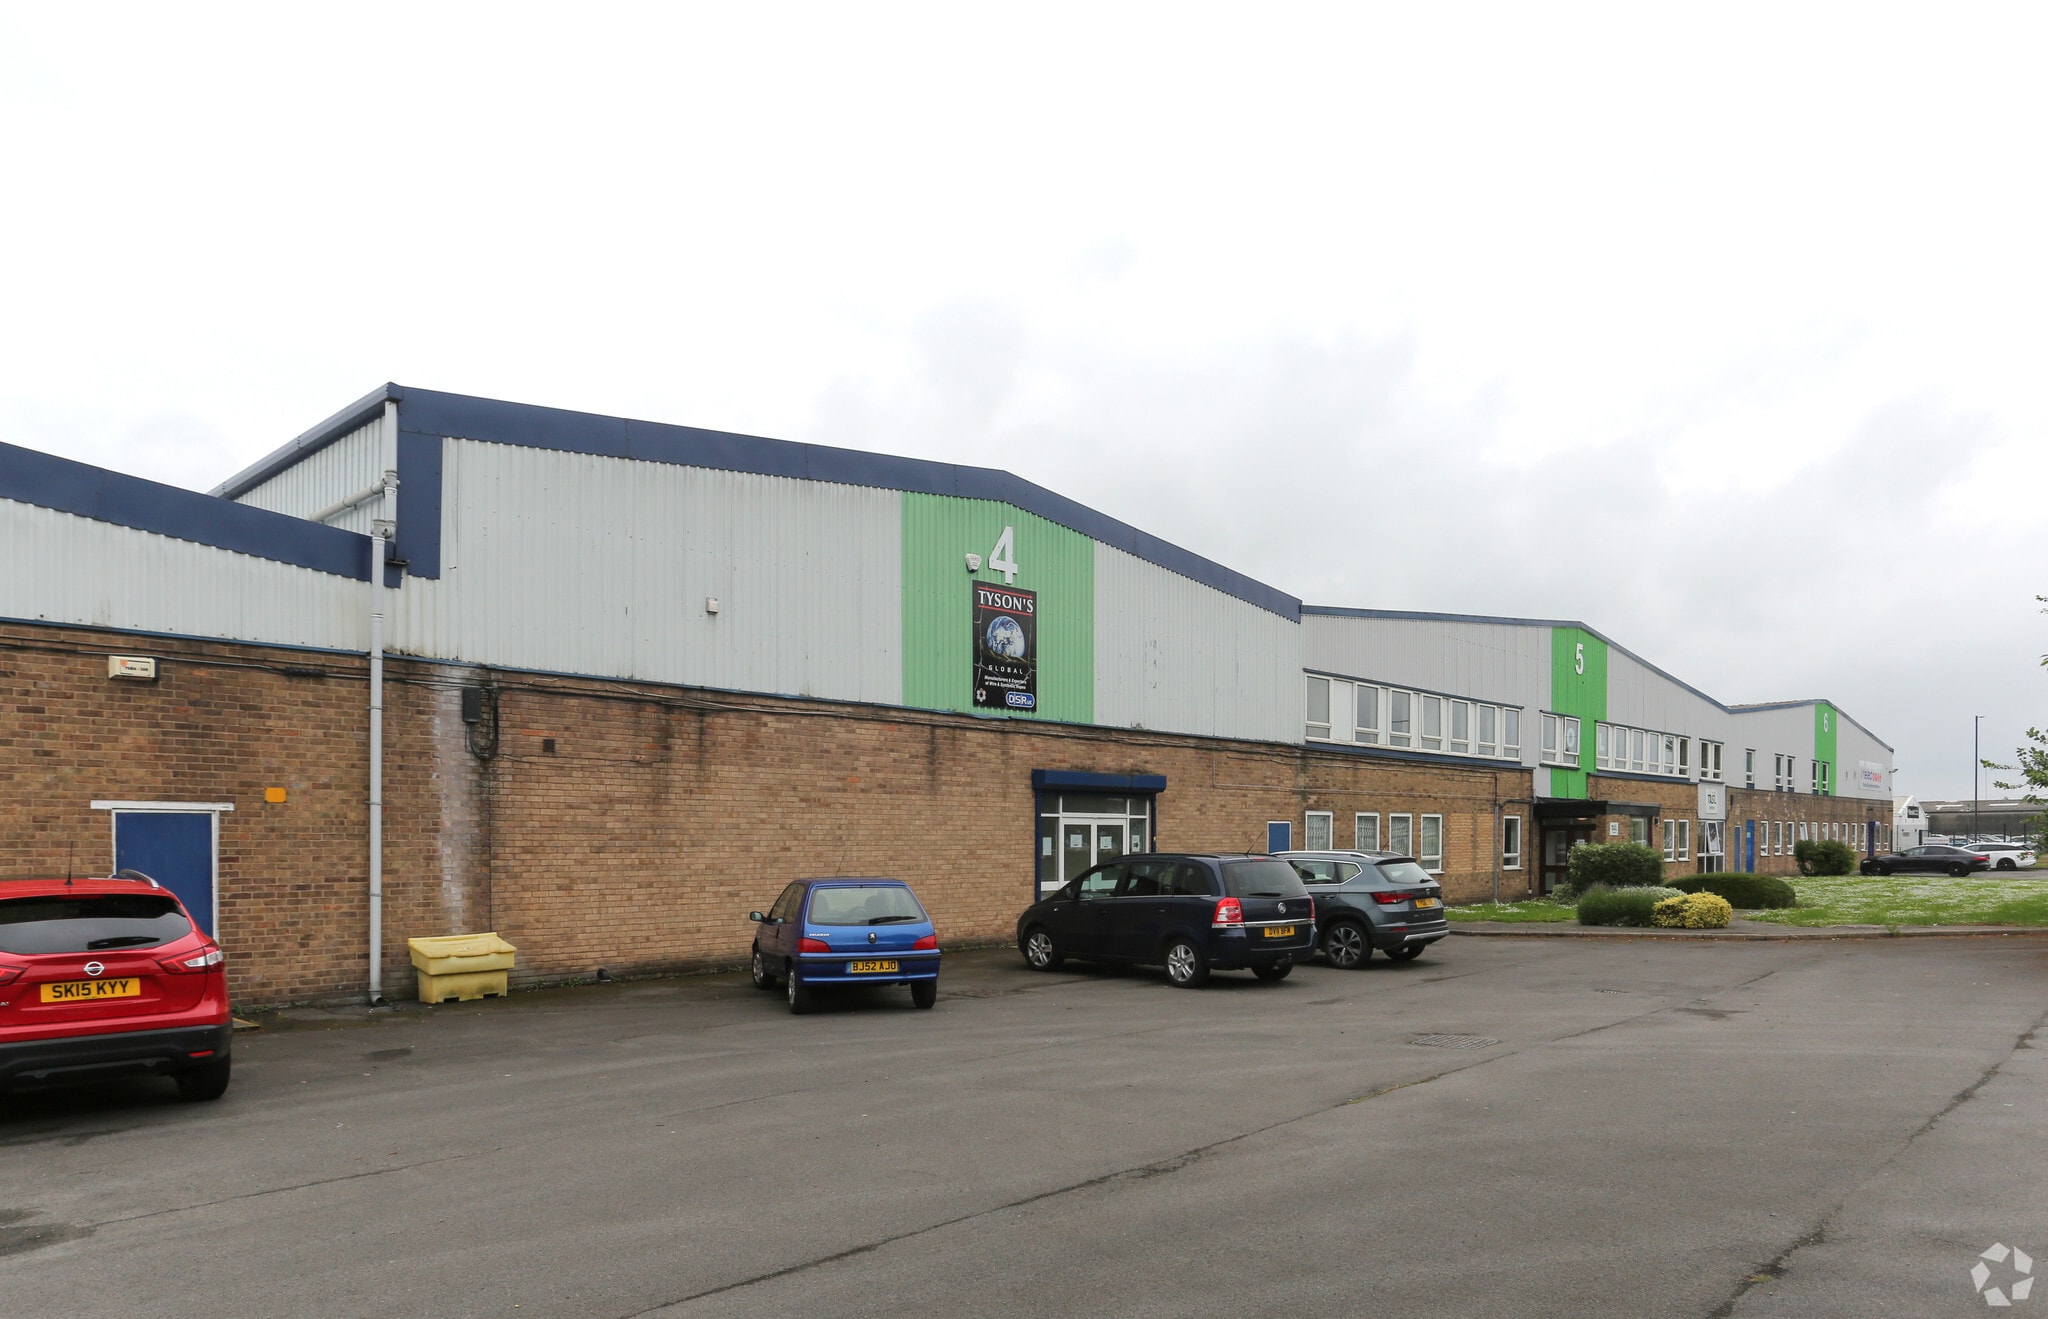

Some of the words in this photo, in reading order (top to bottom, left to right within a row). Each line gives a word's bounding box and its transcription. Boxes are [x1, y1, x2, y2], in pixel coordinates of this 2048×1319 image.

[989, 526, 1018, 584] 4
[978, 591, 1034, 613] TYSON'S
[989, 665, 1023, 674] GLOBAL
[1575, 643, 1584, 675] 5
[1824, 712, 1829, 733] 6
[852, 962, 876, 971] BJ52
[53, 983, 91, 998] SK15
[97, 980, 129, 995] KYY
